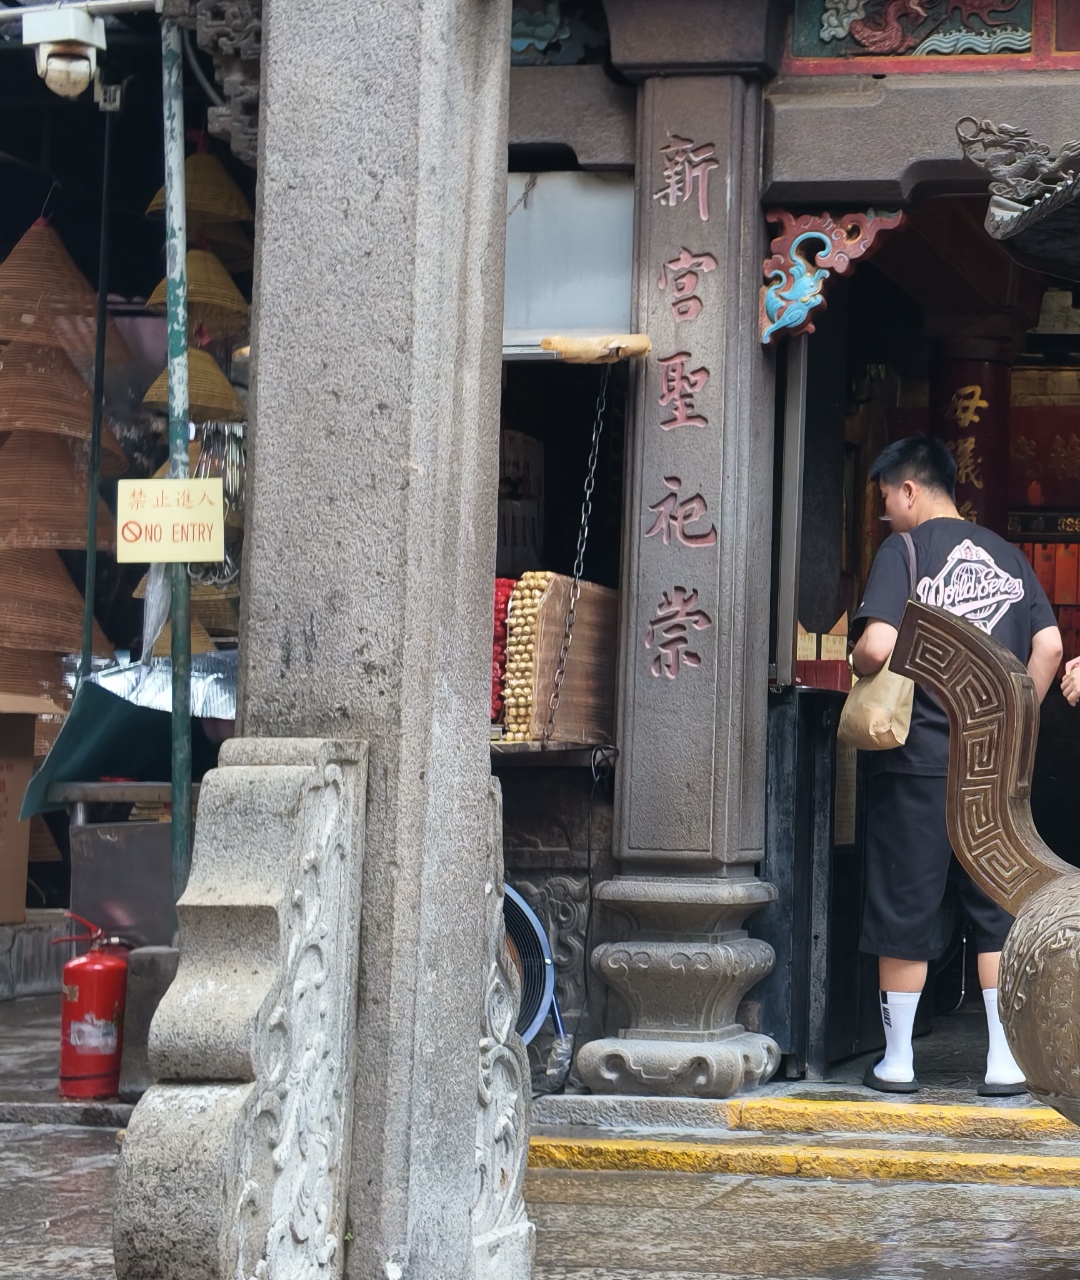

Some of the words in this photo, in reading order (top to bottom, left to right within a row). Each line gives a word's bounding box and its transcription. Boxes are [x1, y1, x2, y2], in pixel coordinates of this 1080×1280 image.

[129, 487, 215, 510] 禁止進入
[145, 523, 163, 543] NO
[172, 523, 214, 543] ENTRY
